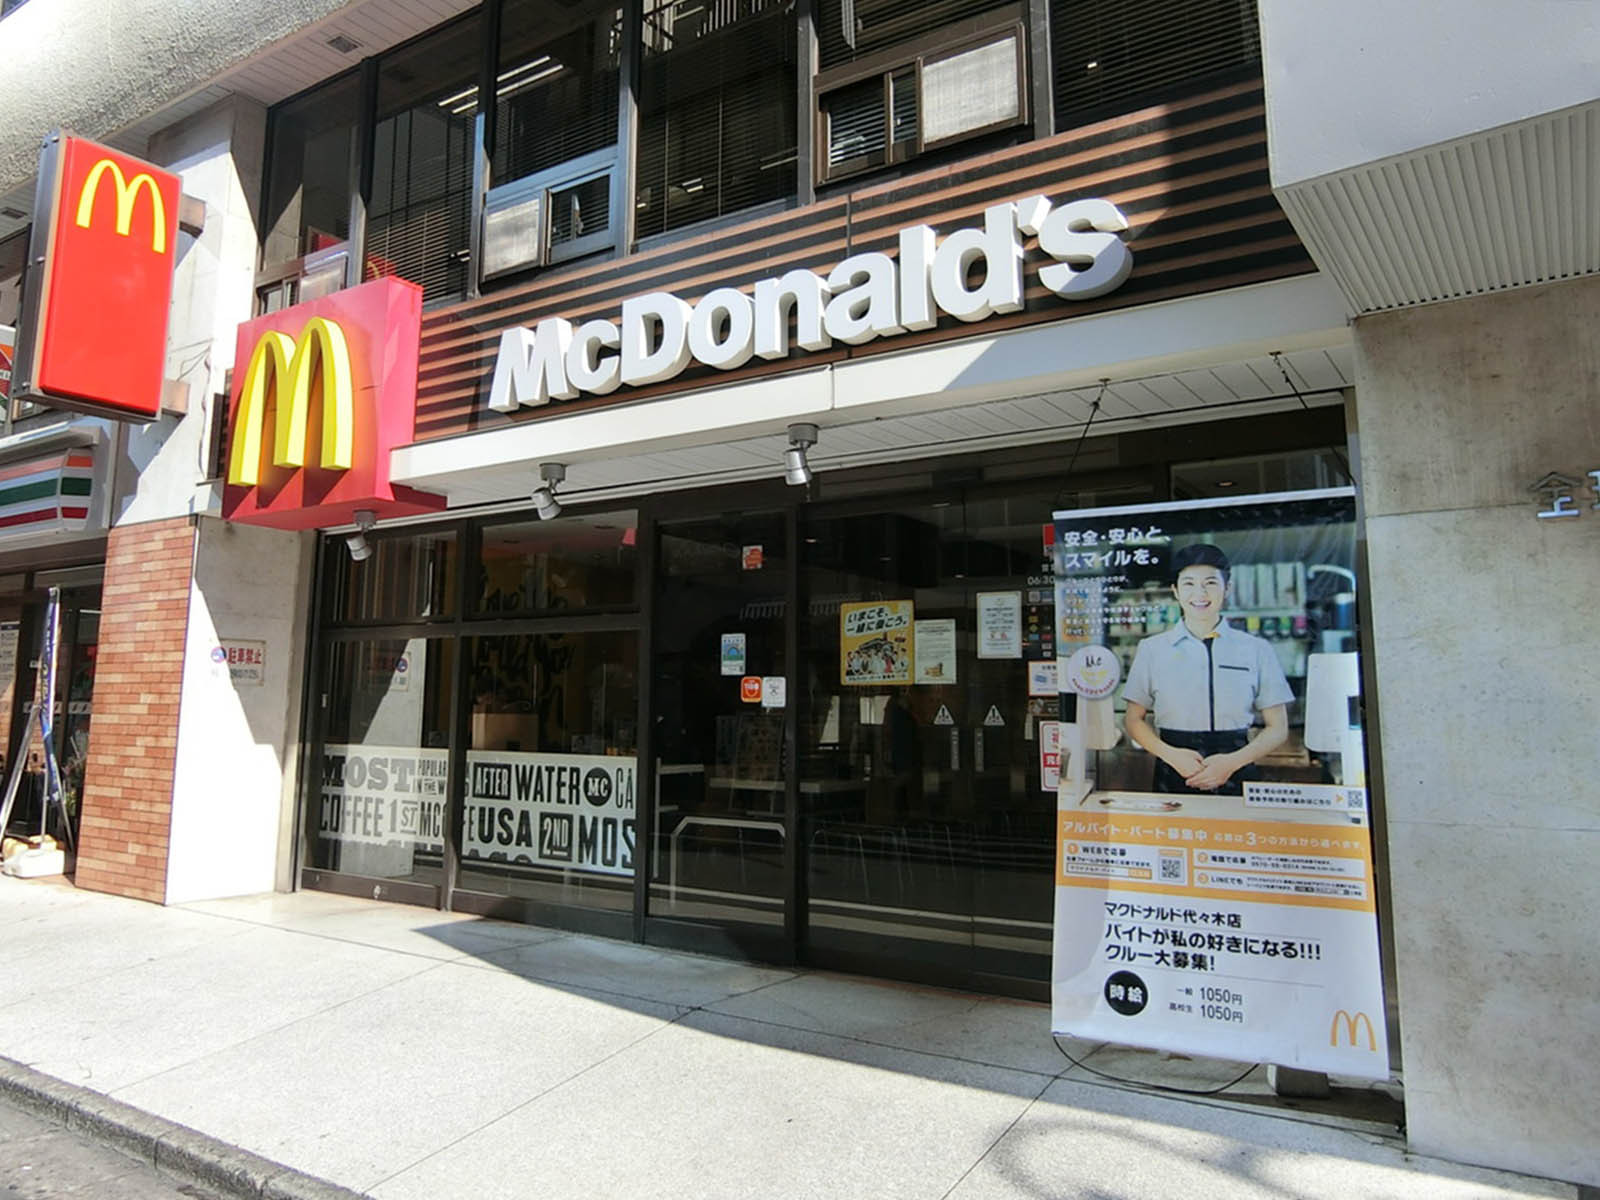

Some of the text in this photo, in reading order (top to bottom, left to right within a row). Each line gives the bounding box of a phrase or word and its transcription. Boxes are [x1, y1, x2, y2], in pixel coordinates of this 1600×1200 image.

[487, 193, 1133, 412] McDonald's
[1065, 549, 1159, 569] スマイルを。
[228, 647, 261, 665] 駐車禁止
[321, 755, 415, 792] MOST
[474, 766, 509, 797] AFTER
[515, 764, 581, 806] WATER
[320, 794, 385, 838] COFFEE
[478, 806, 533, 848] USA
[1104, 901, 1242, 928] マクドナルド代々木店
[1105, 924, 1321, 960] バイトが私の好きになる!!!
[1105, 944, 1215, 971] クルー大募集!
[1200, 986, 1243, 1005] 1050円
[1200, 1004, 1244, 1023] 1050円
